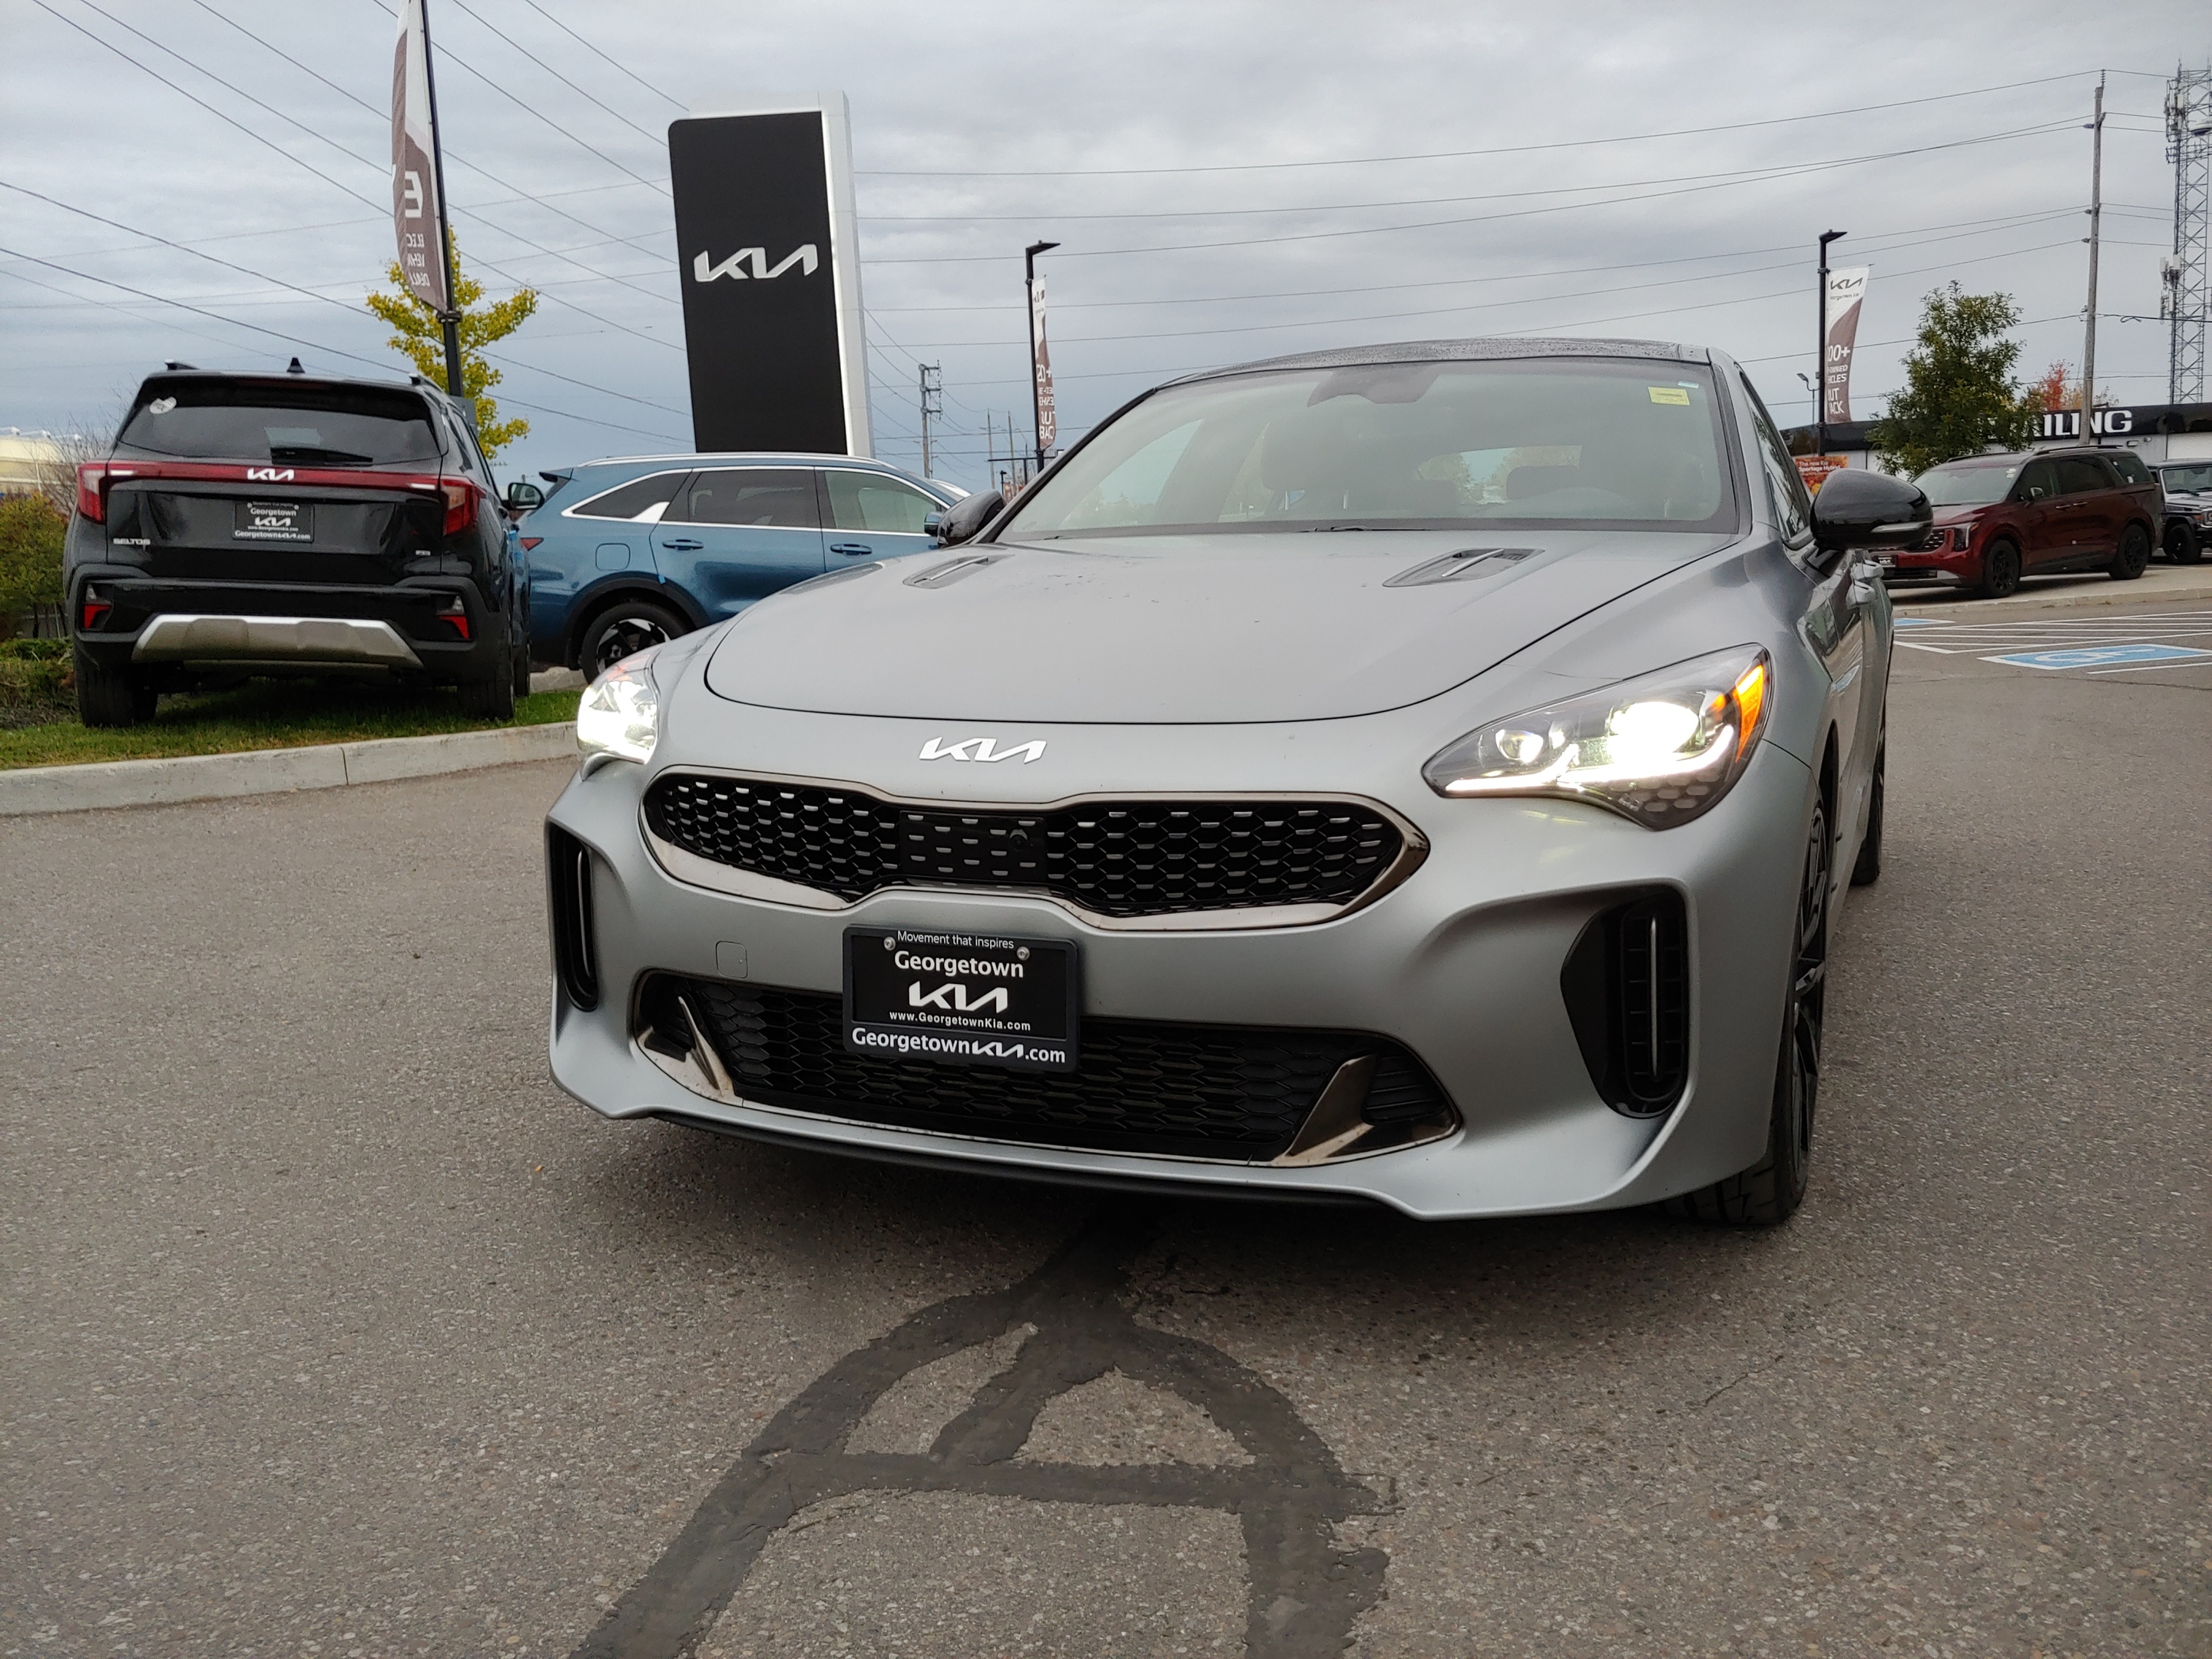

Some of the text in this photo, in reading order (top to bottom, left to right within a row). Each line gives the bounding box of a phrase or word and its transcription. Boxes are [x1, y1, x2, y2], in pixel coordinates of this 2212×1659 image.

[694, 243, 818, 282] KIA
[1830, 277, 1863, 290] KIA
[1829, 400, 1844, 415] ACK
[1038, 426, 1055, 439] BAC
[2034, 410, 2132, 437] ILING
[247, 468, 295, 482] KIA
[250, 507, 296, 517] Georgetown
[254, 516, 291, 526] KIA
[919, 737, 1048, 764] KIA
[897, 930, 1014, 949] Movement that inspires
[894, 950, 1024, 978] Georgetown
[909, 980, 1008, 1014] KIA
[889, 1012, 1031, 1031] www.GeorgetownKia.com
